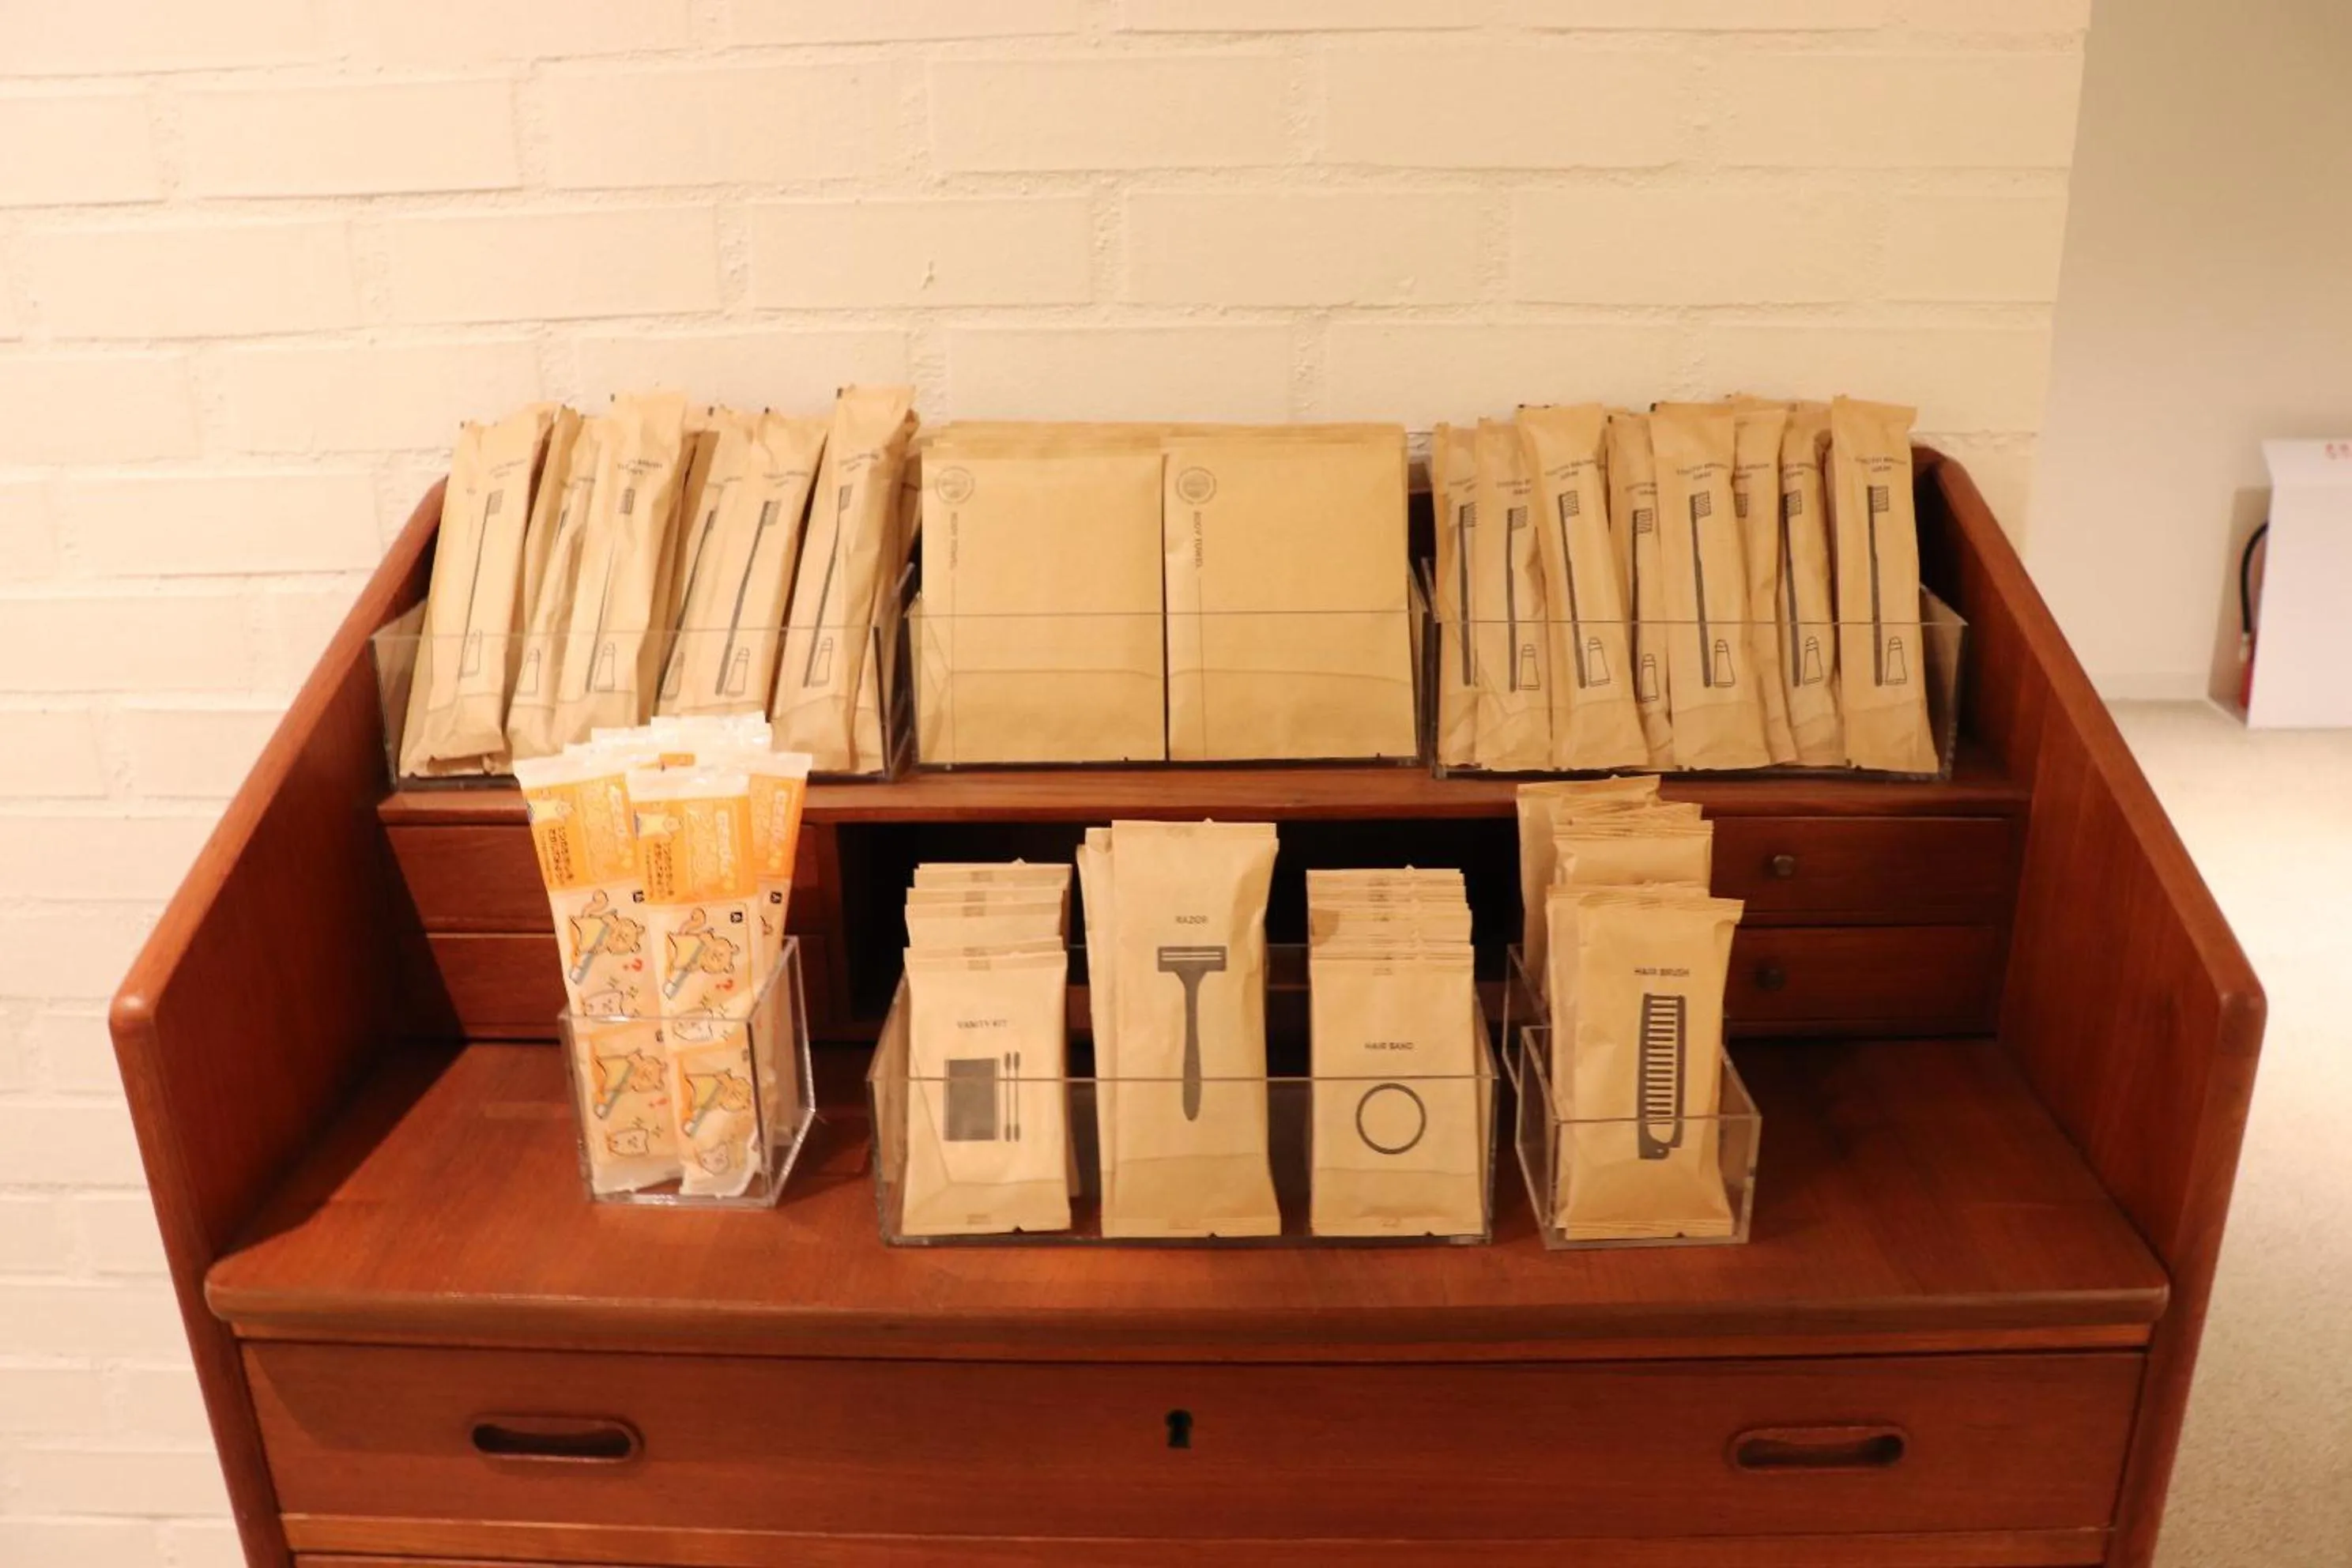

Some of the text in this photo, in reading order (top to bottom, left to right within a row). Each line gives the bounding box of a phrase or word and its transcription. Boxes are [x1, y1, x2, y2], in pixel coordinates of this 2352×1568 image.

[1175, 914, 1208, 925] RAZOR
[1660, 968, 1690, 977] BRUSH
[957, 1019, 990, 1029] VANITY
[1364, 1042, 1413, 1050] HAIR BAND
